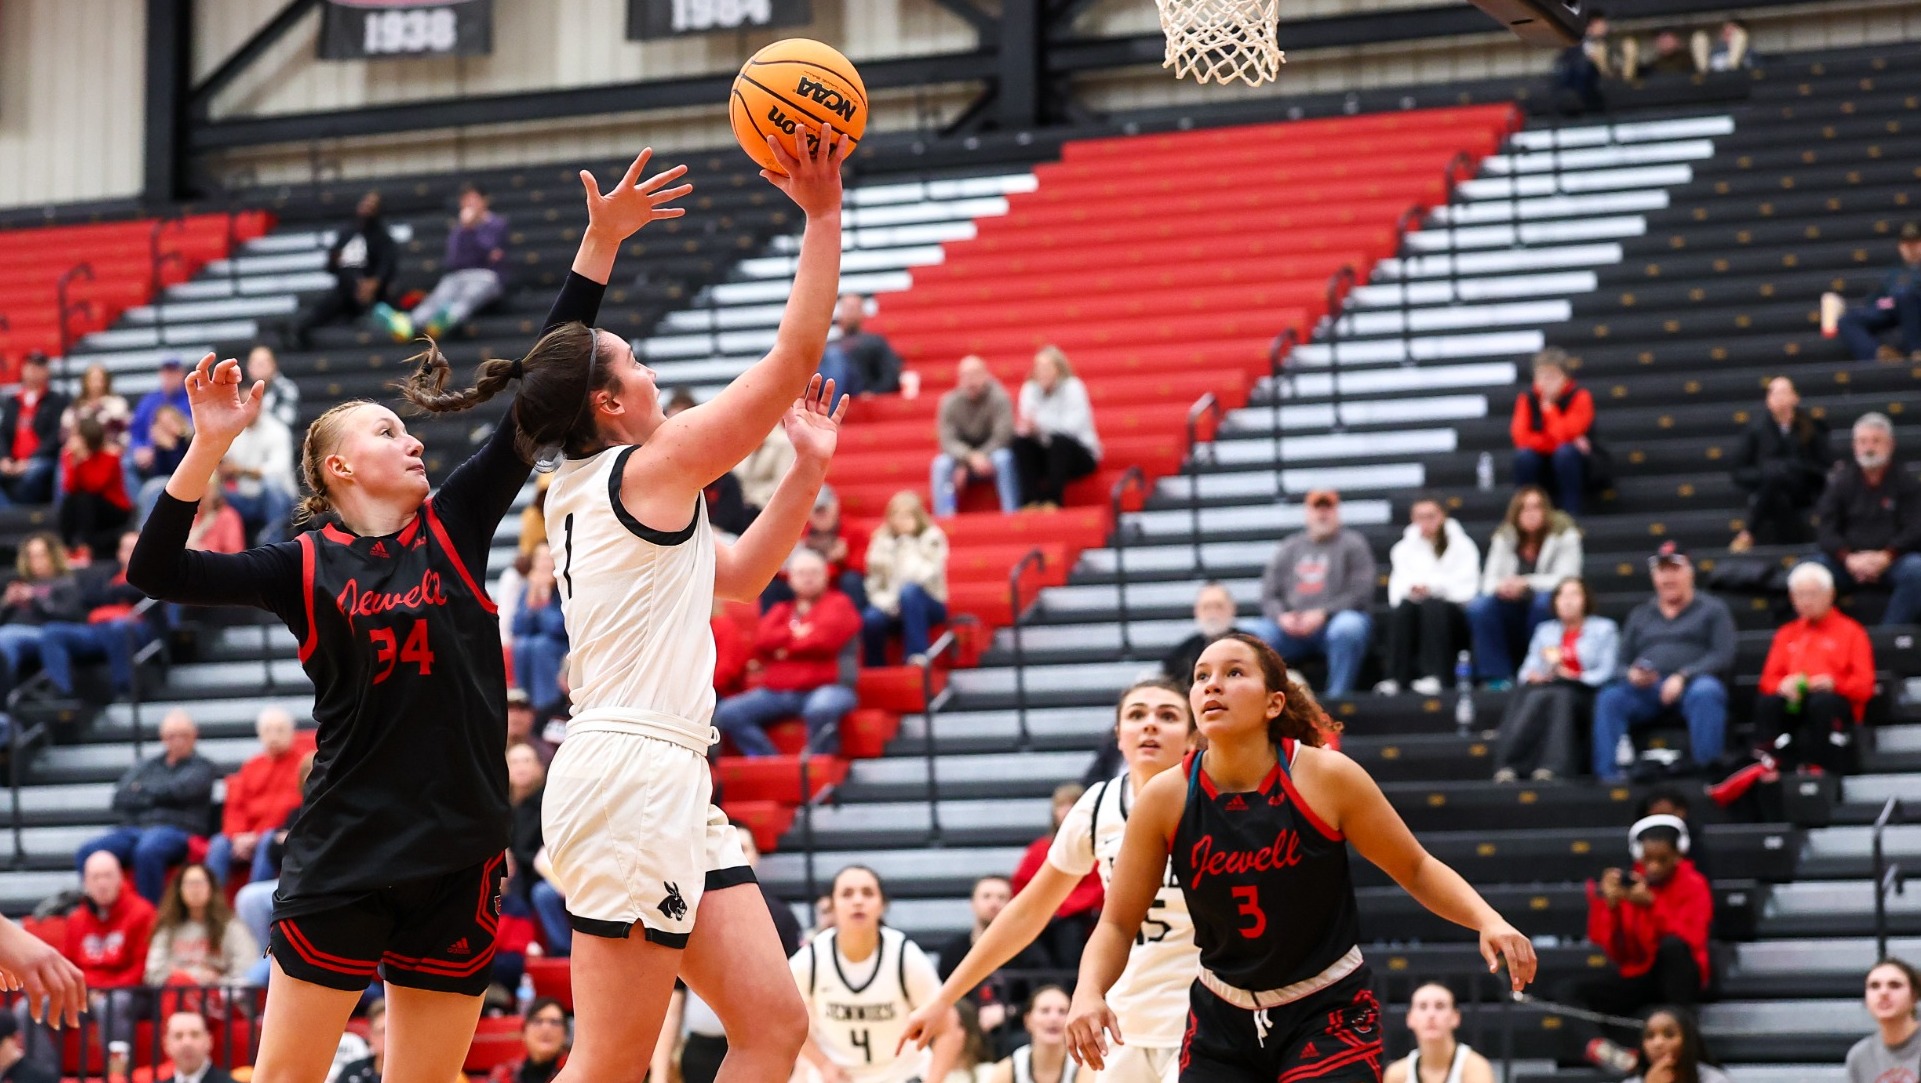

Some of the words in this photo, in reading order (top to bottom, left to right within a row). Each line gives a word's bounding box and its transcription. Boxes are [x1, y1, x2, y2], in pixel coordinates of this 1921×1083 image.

[364, 8, 458, 53] 1938
[671, 0, 772, 31] 1984
[796, 76, 857, 122] NCAA
[563, 512, 574, 600] 1
[336, 568, 448, 637] Jewell
[369, 618, 434, 685] 34
[1191, 828, 1302, 891] Jewell
[1231, 885, 1267, 939] 3
[850, 1028, 872, 1063] 4
